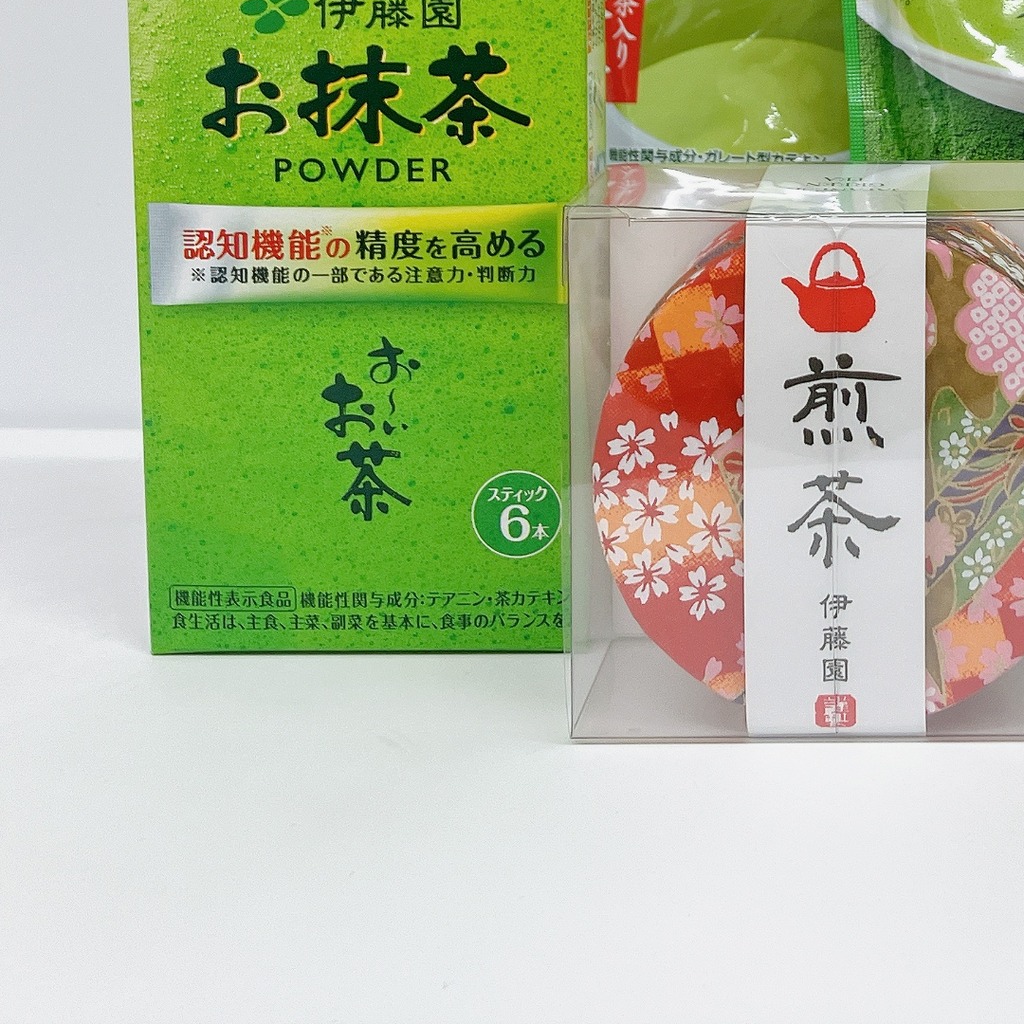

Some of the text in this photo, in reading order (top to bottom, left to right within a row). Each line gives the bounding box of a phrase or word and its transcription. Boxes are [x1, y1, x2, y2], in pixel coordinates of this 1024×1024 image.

[201, 41, 533, 148] お抹茶
[273, 157, 453, 183] POWDER
[784, 352, 902, 570] 煎茶
[486, 485, 549, 503] スティック
[499, 504, 550, 543] 6本
[174, 589, 292, 609] 機能性表示食品
[818, 592, 854, 683] 伊藤園
